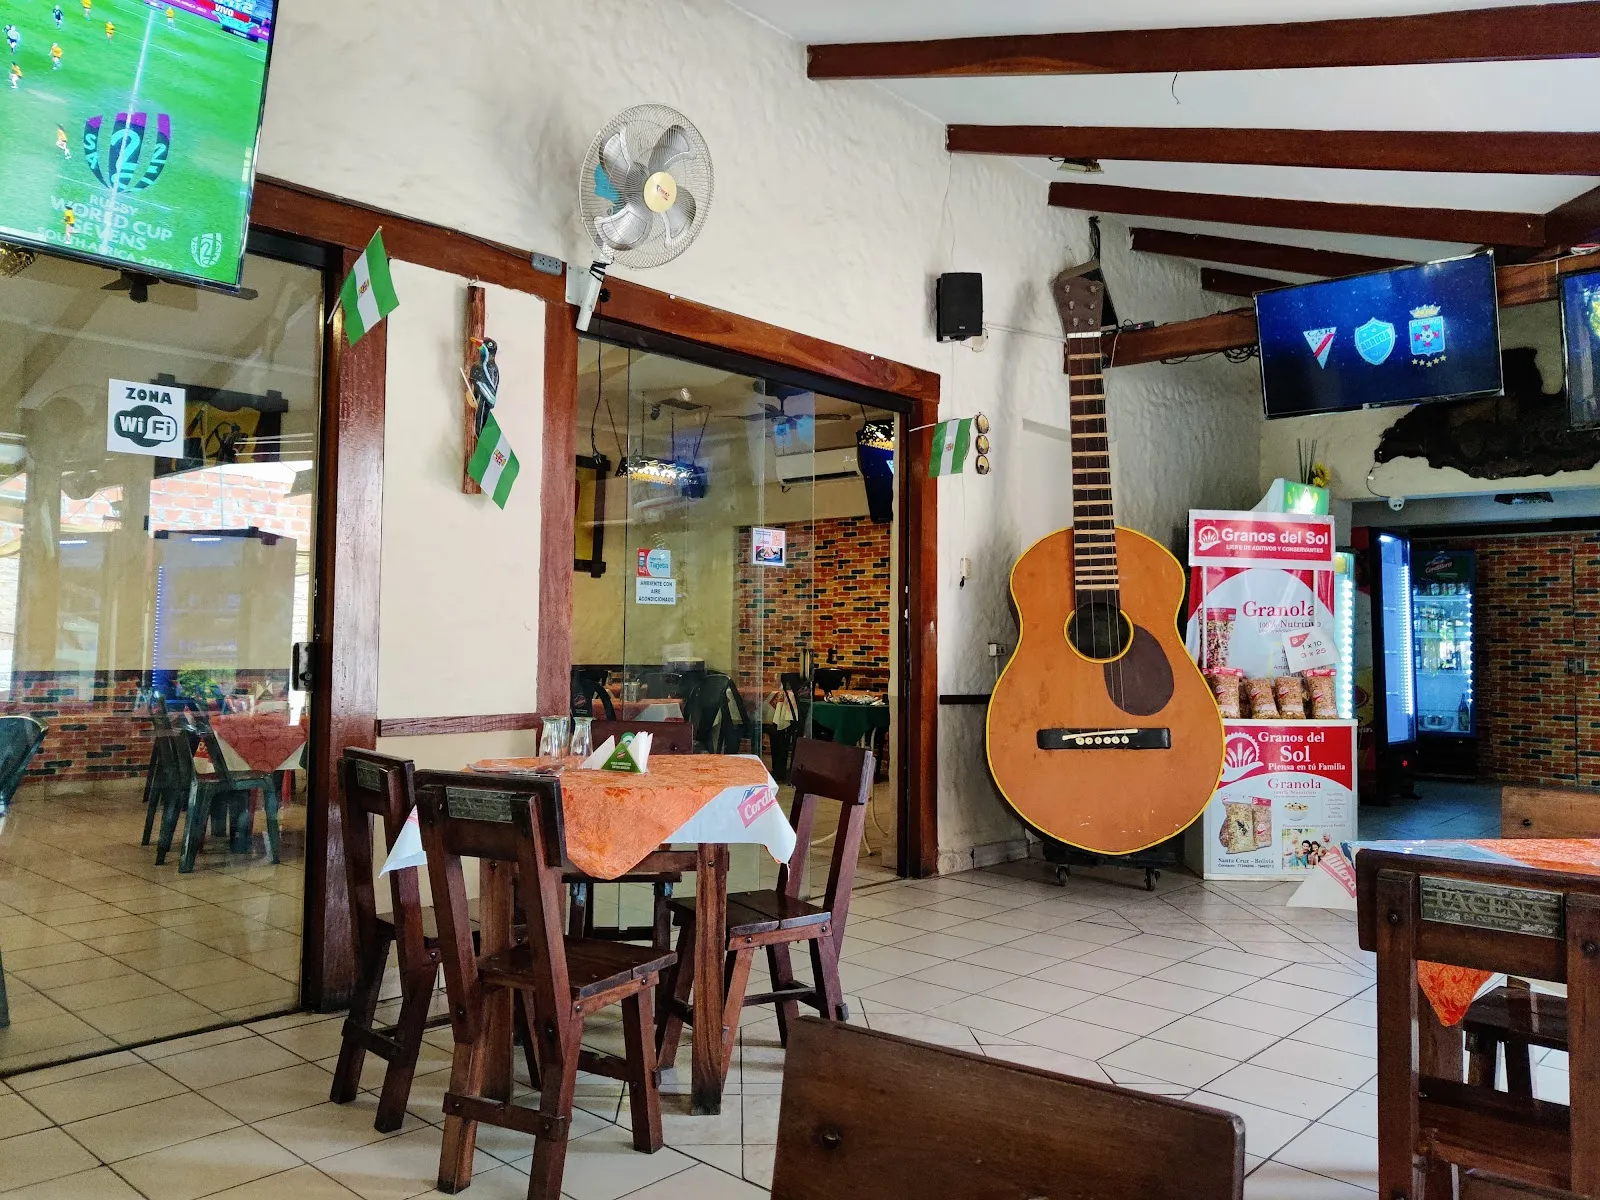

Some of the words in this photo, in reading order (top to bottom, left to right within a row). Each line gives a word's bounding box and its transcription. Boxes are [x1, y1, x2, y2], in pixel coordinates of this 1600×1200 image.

[215, 4, 234, 17] VIVO
[51, 195, 129, 230] WORD
[132, 220, 173, 241] CUP
[125, 387, 173, 404] ZONA
[1221, 528, 1276, 543] Granos
[1280, 531, 1301, 544] del
[1305, 532, 1328, 545] Sol
[1242, 600, 1314, 617] Granola
[1258, 731, 1304, 743] Granos
[1306, 731, 1325, 743] del
[1280, 745, 1311, 762] Sol
[1267, 778, 1322, 789] Granola
